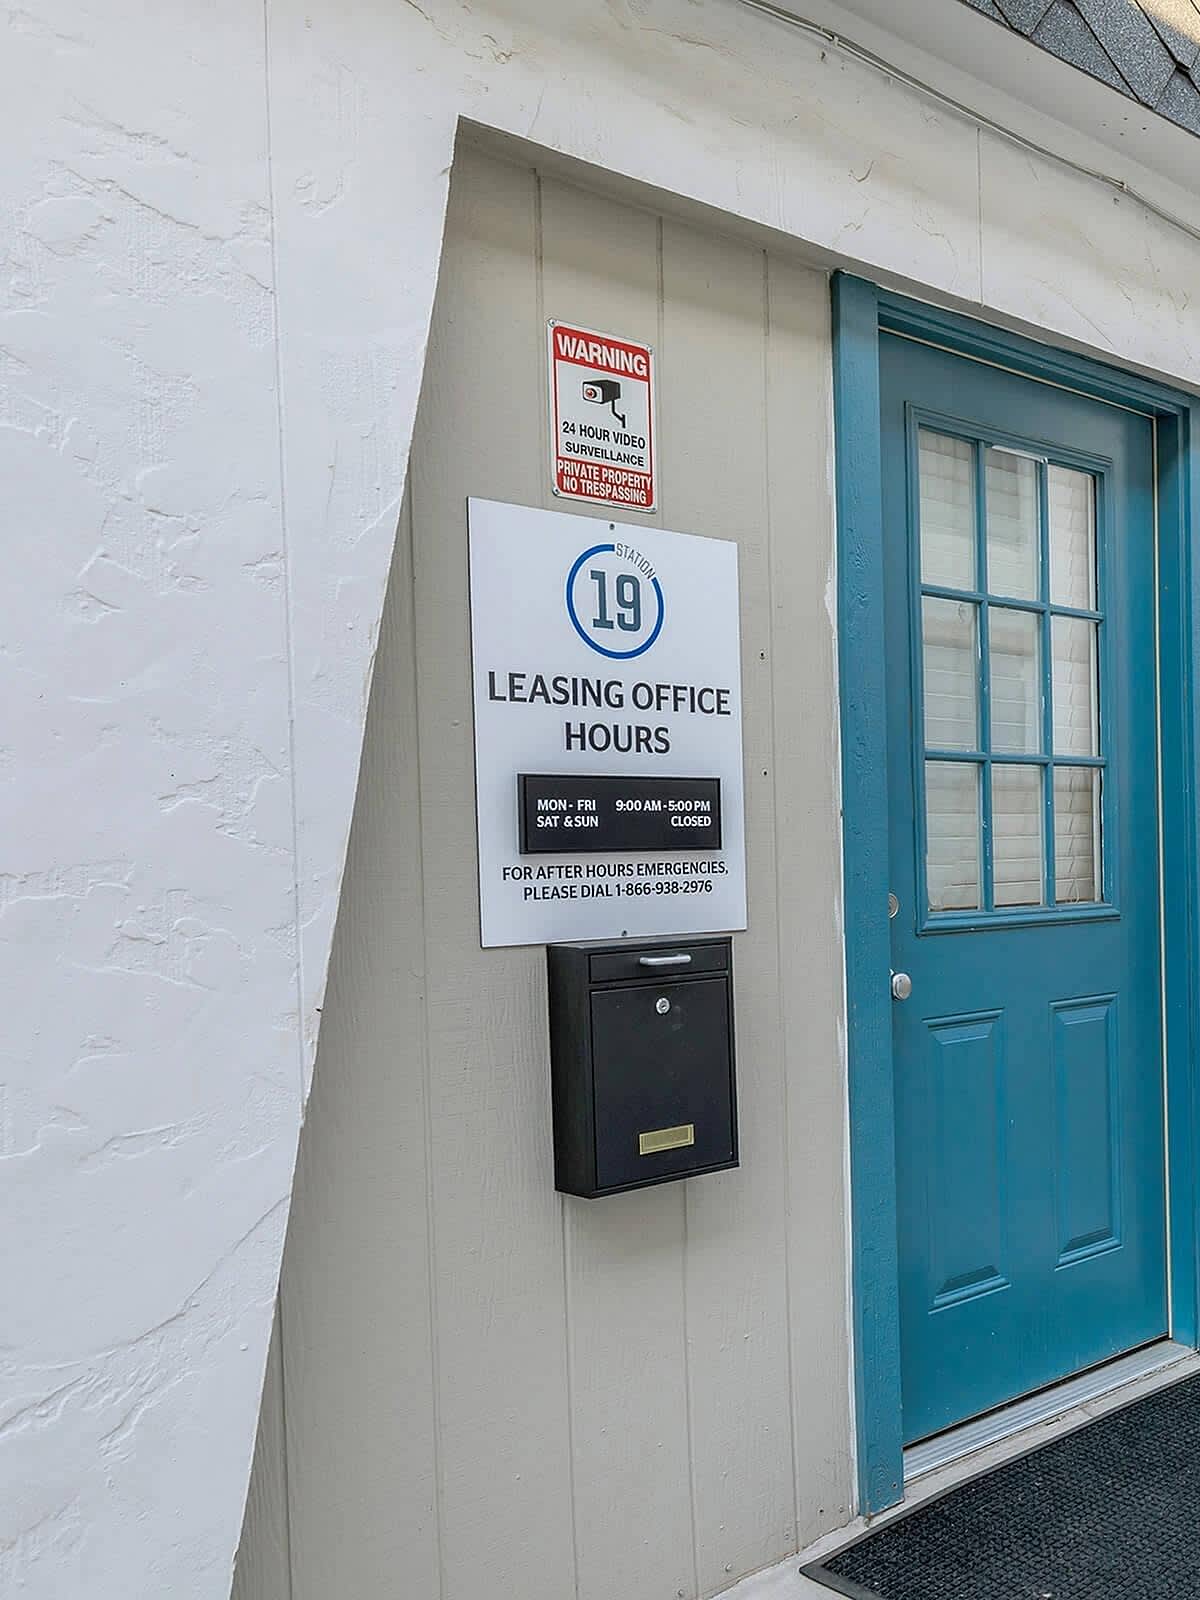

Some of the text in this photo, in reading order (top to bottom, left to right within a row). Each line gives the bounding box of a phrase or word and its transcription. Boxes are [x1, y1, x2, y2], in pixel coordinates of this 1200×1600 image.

[556, 333, 648, 377] WARNING
[562, 420, 646, 450] 24 HOUR VIDEO
[564, 441, 645, 467] SURVEILLANCE
[557, 459, 652, 490] PRIVATE PROPERTY
[563, 475, 648, 504] NO TRESPASSING
[615, 542, 656, 580] STATION
[589, 569, 642, 632] 19
[488, 671, 731, 715] LEASING OFFICE
[565, 721, 670, 754] HOURS
[577, 799, 597, 811] FRI
[615, 800, 642, 811] 9:00
[694, 801, 711, 812] PM
[536, 815, 560, 828] SAT
[671, 815, 712, 827] CLOSED
[502, 861, 729, 881] FOR AFTER HOURS EMERGENCIES,
[524, 880, 713, 901] PLEASE DIAL 1-866-938-2976
